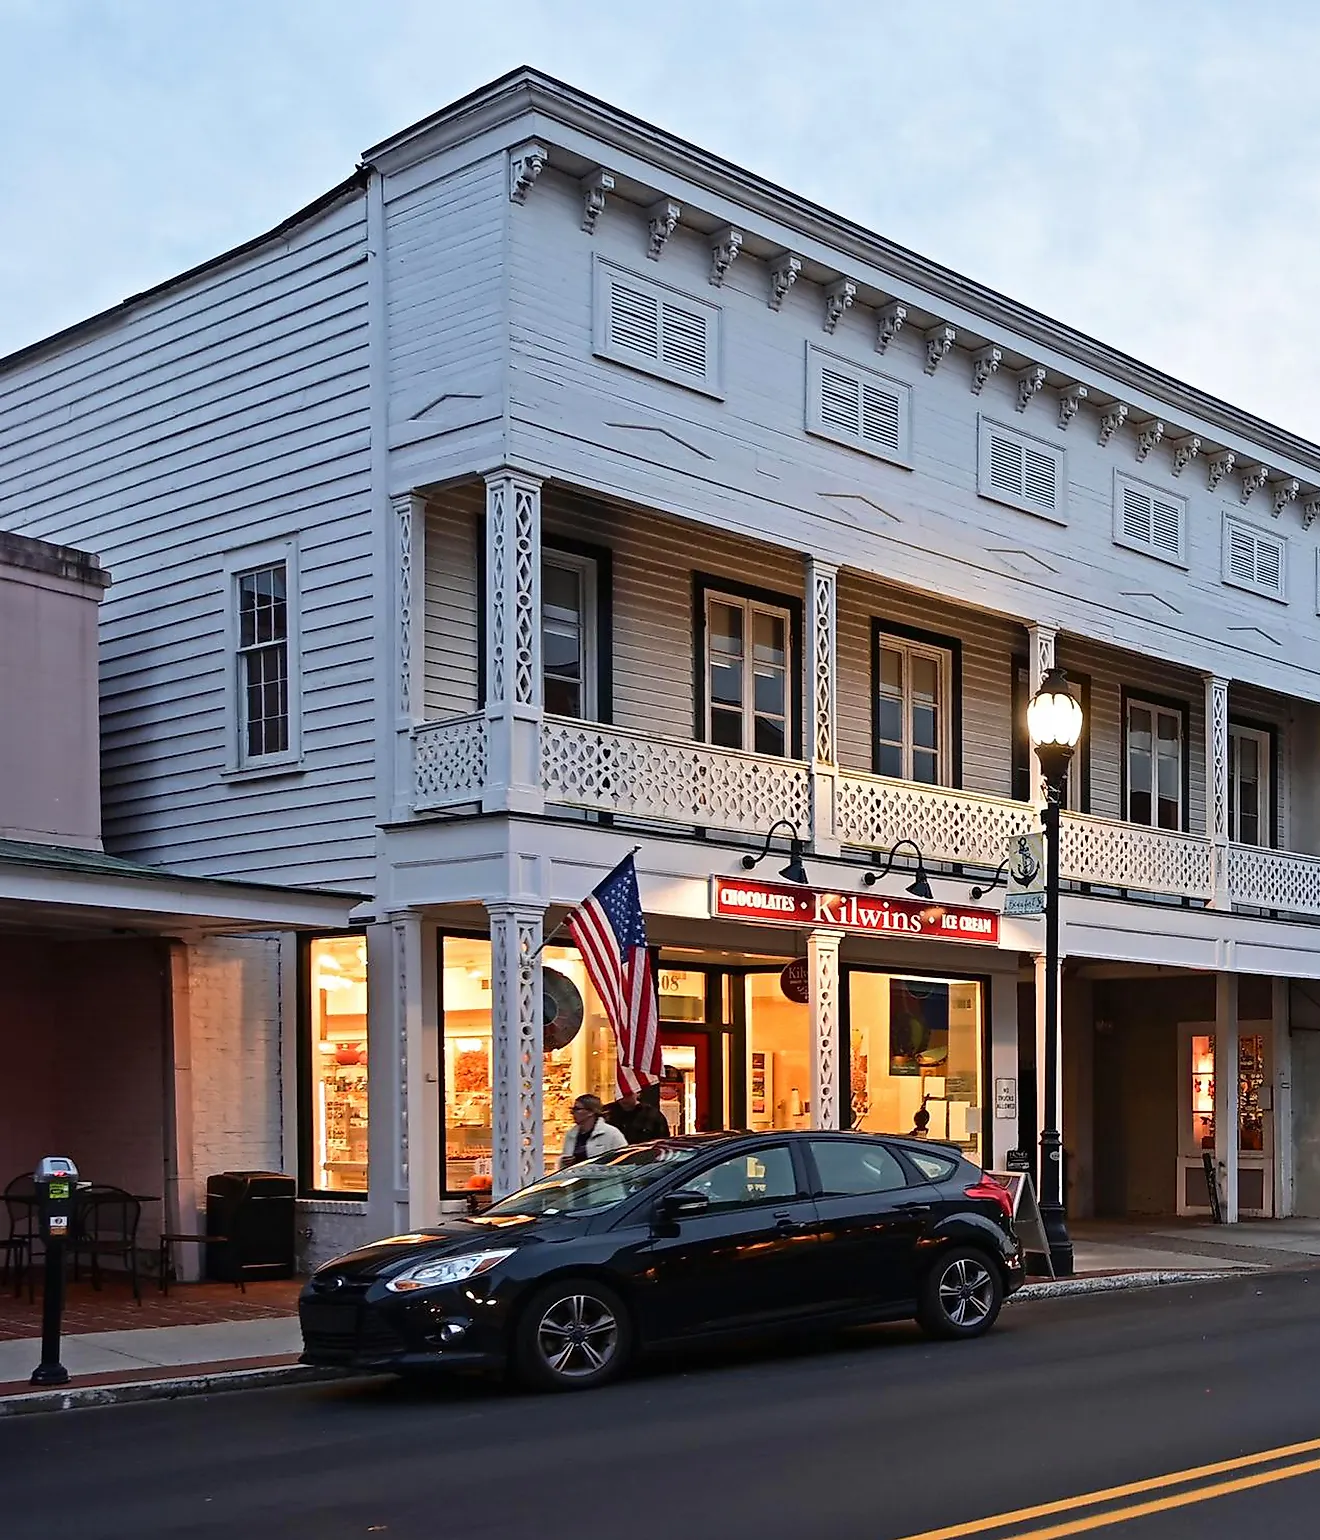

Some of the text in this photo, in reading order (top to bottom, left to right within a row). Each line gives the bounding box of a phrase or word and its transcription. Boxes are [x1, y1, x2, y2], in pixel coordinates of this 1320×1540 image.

[721, 888, 992, 934] CHOCOLATES Kilwins ICE CREAM
[658, 974, 679, 991] 08
